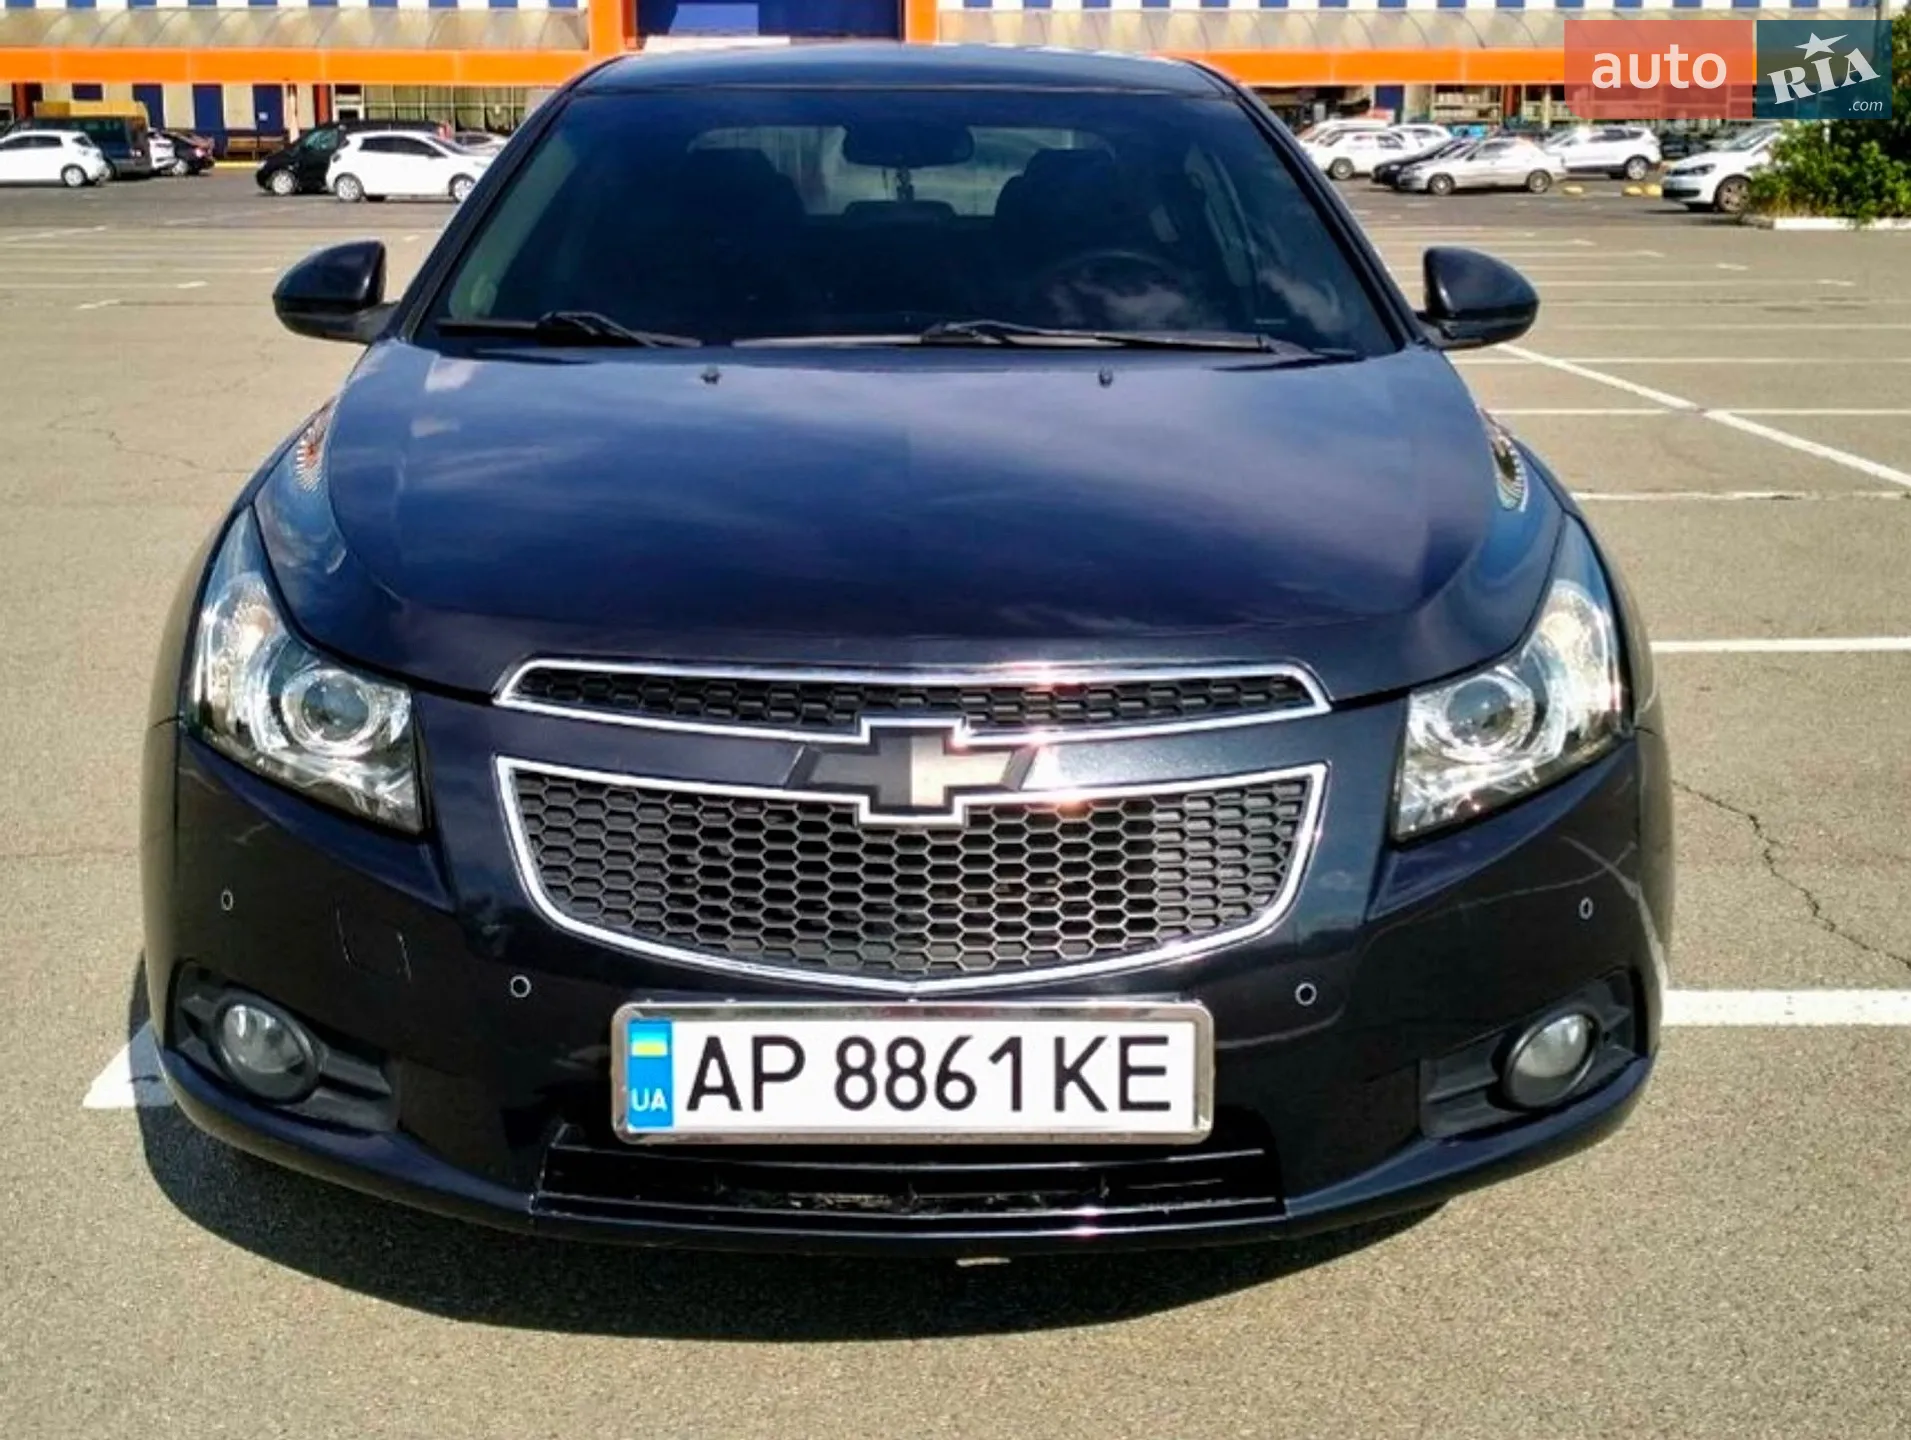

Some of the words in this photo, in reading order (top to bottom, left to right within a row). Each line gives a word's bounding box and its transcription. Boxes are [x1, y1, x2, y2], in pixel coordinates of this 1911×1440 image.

[686, 1035, 806, 1112] AP
[834, 1035, 1022, 1112] 8861
[1053, 1035, 1171, 1112] KE
[631, 1089, 667, 1111] UA
